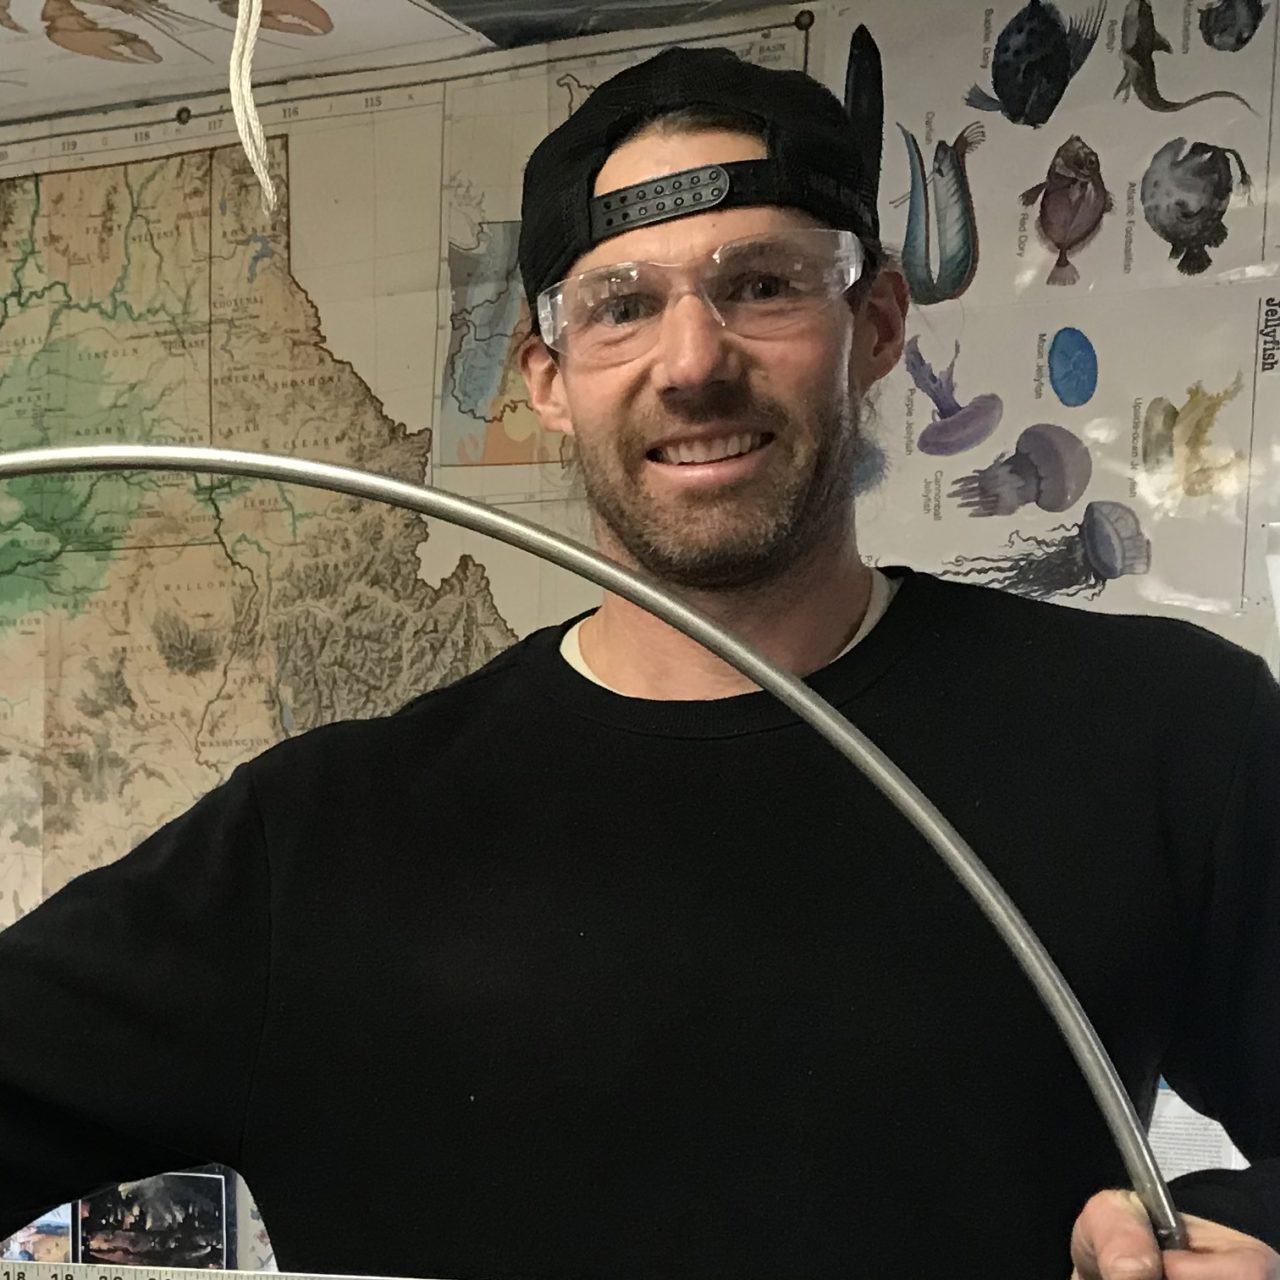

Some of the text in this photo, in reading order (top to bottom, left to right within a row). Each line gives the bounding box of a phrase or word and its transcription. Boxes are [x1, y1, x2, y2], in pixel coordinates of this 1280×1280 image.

[364, 97, 382, 108] 115
[282, 108, 299, 119] 116
[1016, 213, 1029, 258] Red Dory
[1260, 297, 1280, 373] Jellyfish
[78, 348, 139, 361] LINCOLN
[905, 388, 917, 417] Purple
[933, 470, 944, 521] Cannonball
[200, 738, 269, 748] WASHINGTON
